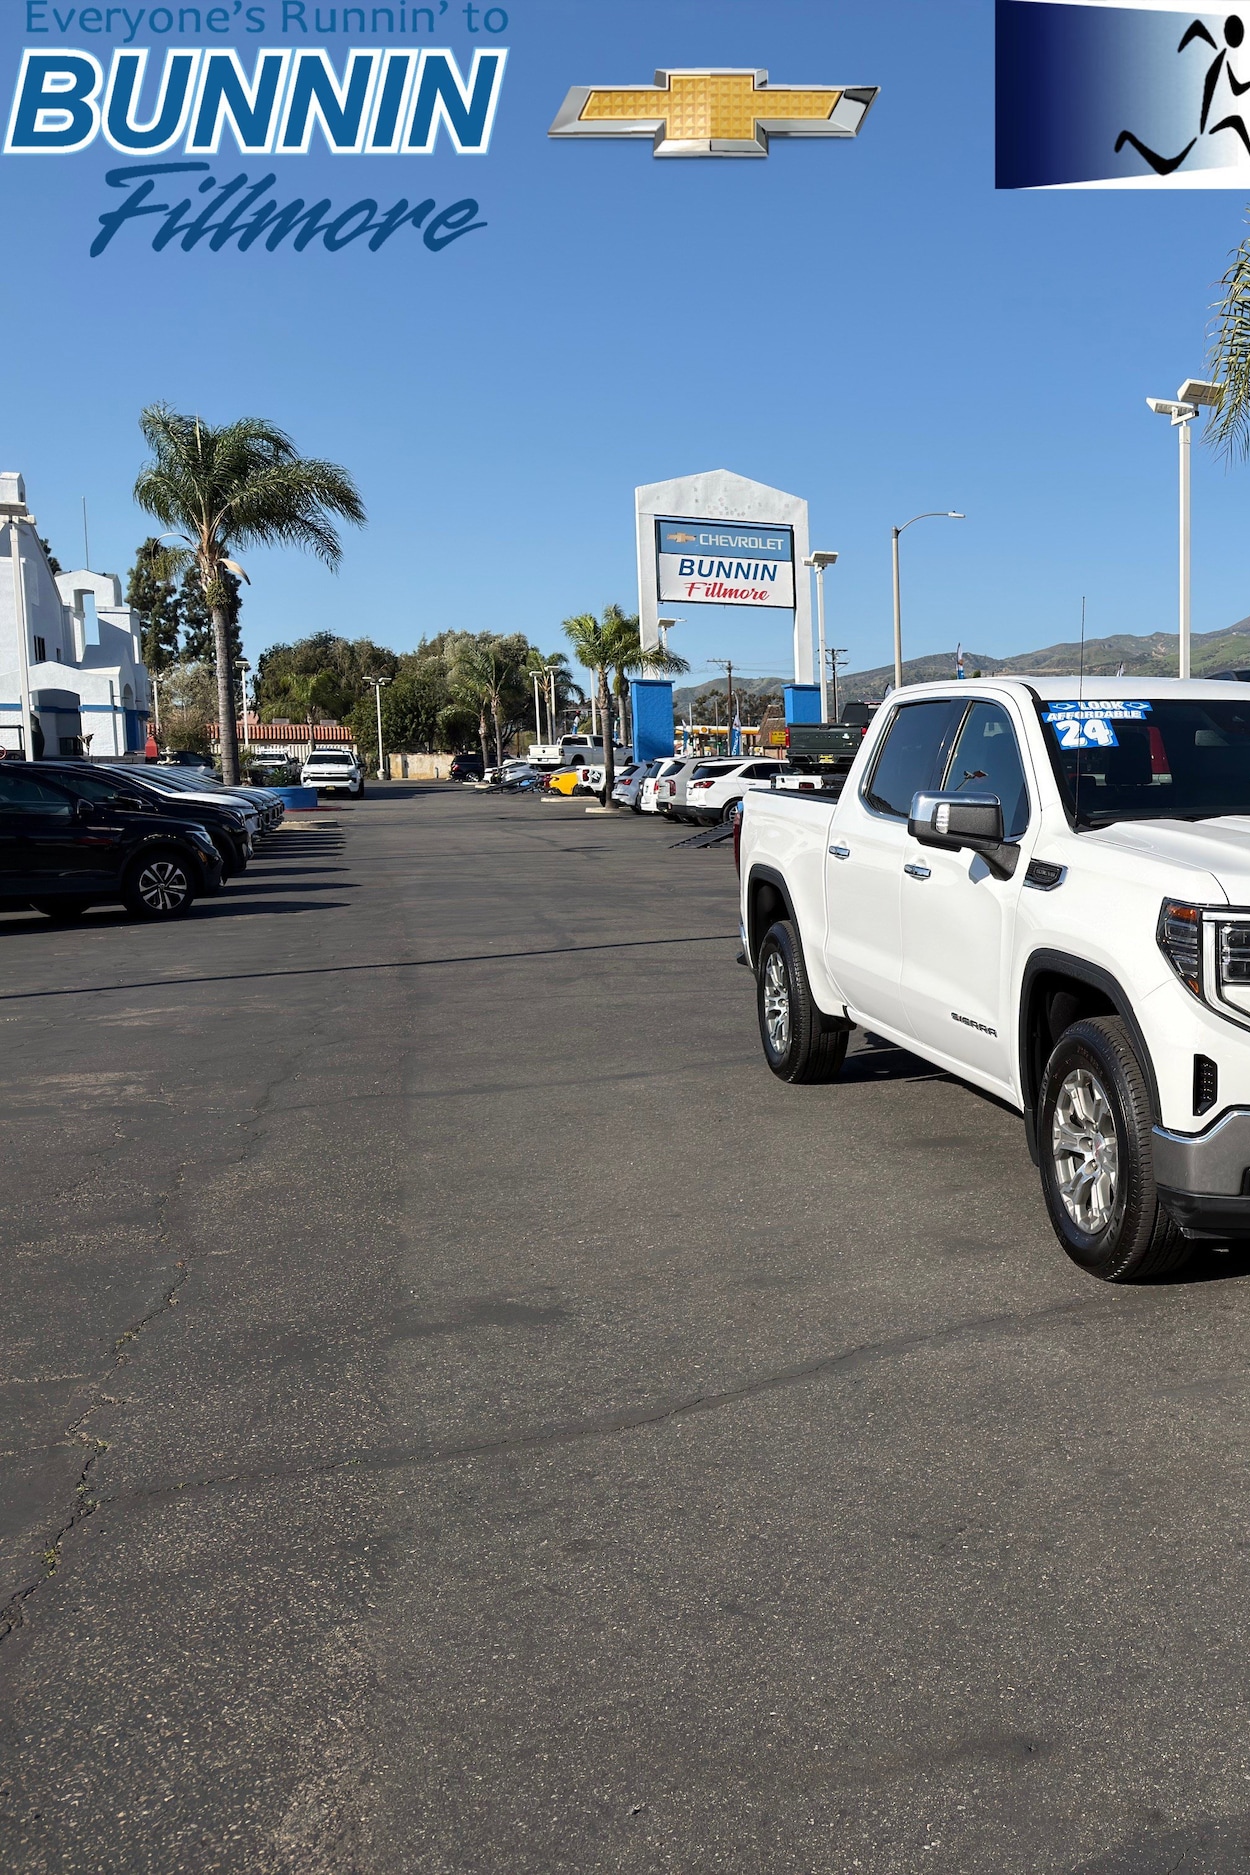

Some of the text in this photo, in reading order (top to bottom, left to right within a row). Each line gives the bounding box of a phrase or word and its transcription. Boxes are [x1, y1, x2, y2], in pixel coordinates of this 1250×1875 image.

[700, 534, 784, 550] CHEVROLET
[679, 559, 778, 581] BUNNIN
[685, 582, 770, 601] Fillmore
[1047, 710, 1141, 721] AFFORDABLE
[1077, 701, 1127, 711] LOOK
[1055, 719, 1114, 748] 24
[950, 1012, 998, 1038] SIERRA
